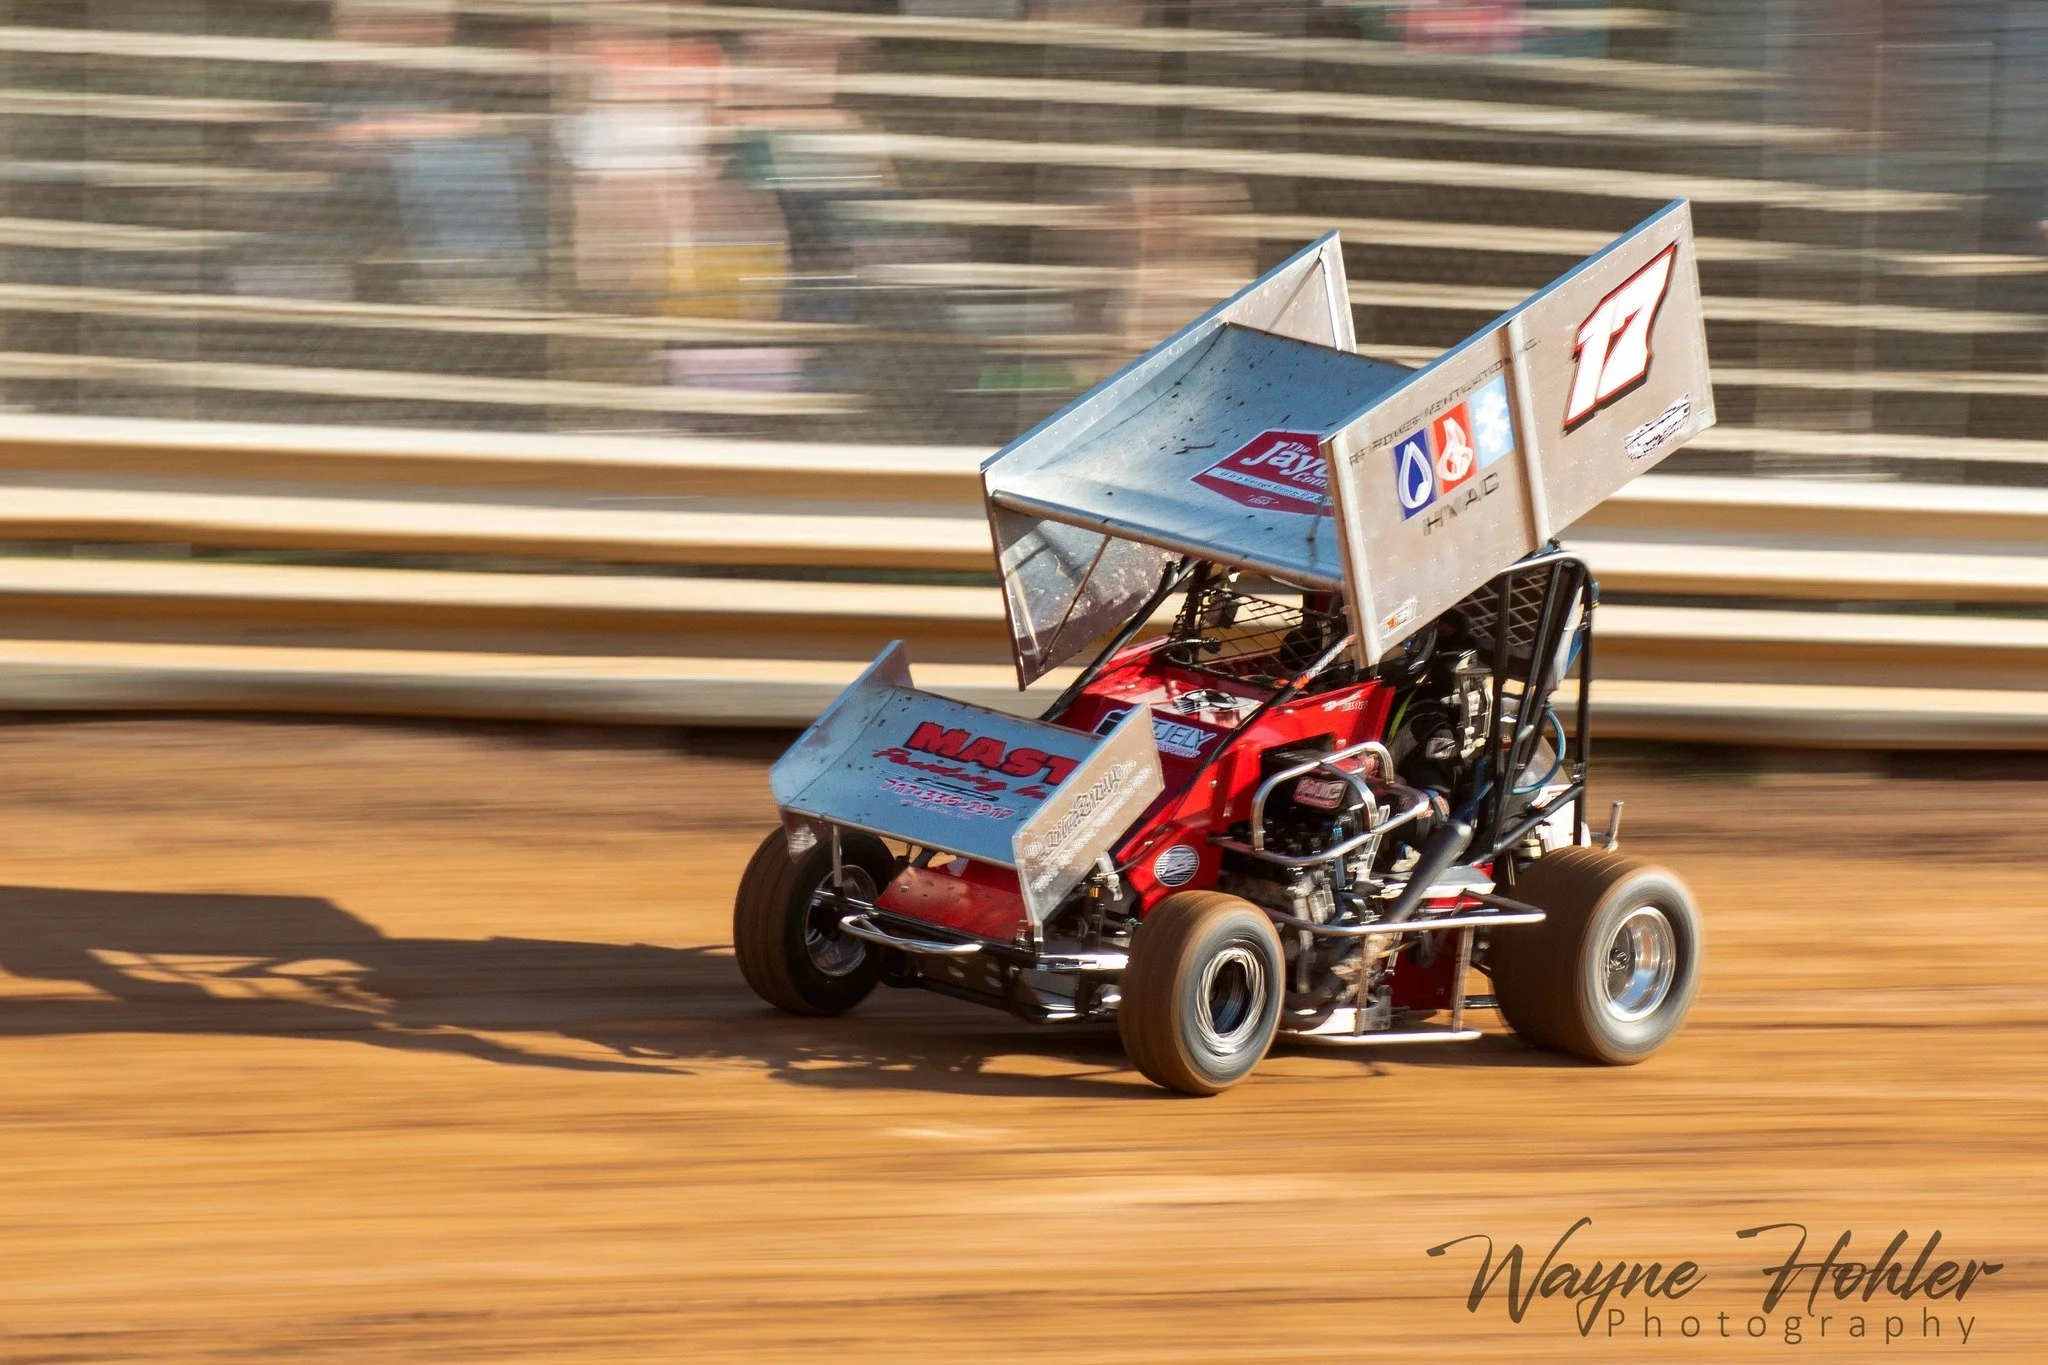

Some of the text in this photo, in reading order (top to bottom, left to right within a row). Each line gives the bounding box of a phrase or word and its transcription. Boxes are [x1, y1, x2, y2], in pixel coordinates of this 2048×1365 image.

[1562, 242, 1678, 432] 17
[1287, 441, 1312, 453] The
[1422, 471, 1500, 537] HVAC
[903, 721, 1083, 786] MAST
